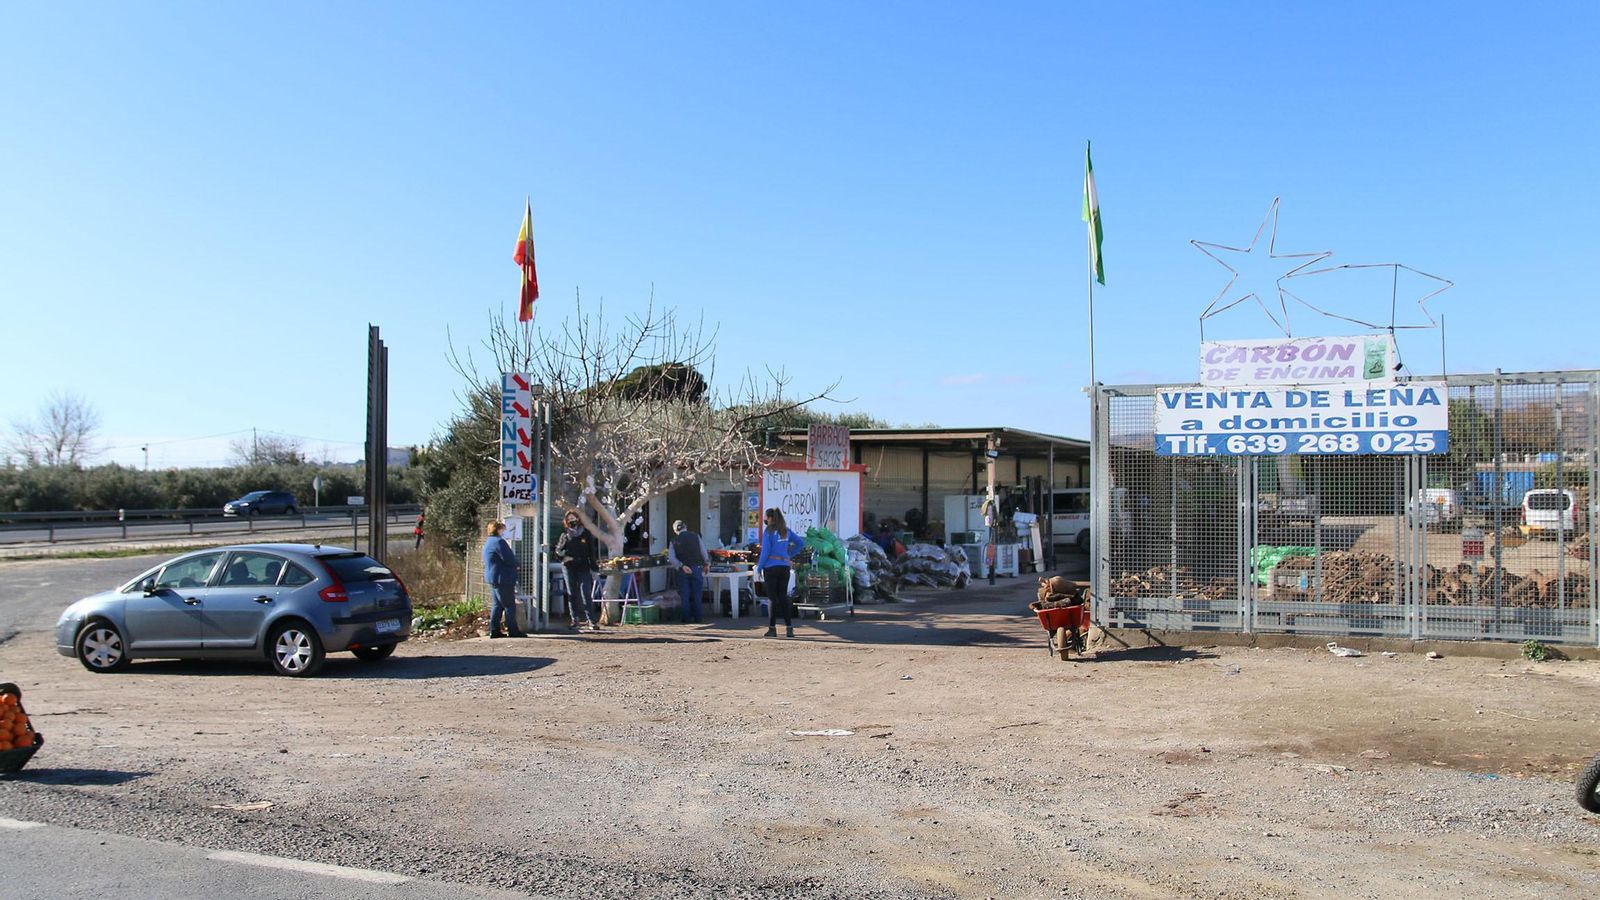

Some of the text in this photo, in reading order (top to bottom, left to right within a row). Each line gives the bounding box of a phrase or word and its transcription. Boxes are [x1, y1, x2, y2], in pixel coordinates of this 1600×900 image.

[1205, 339, 1356, 364] CARBÓN
[1206, 365, 1356, 381] DE ENCINA
[1161, 383, 1441, 409] VENTA DE LEÑA
[1180, 411, 1418, 431] a domicilio
[1165, 432, 1436, 454] Tlf. 639 268 025
[817, 450, 842, 468] SACOS
[503, 486, 531, 500] LÓPEZ
[782, 488, 817, 515] CARBÓN
